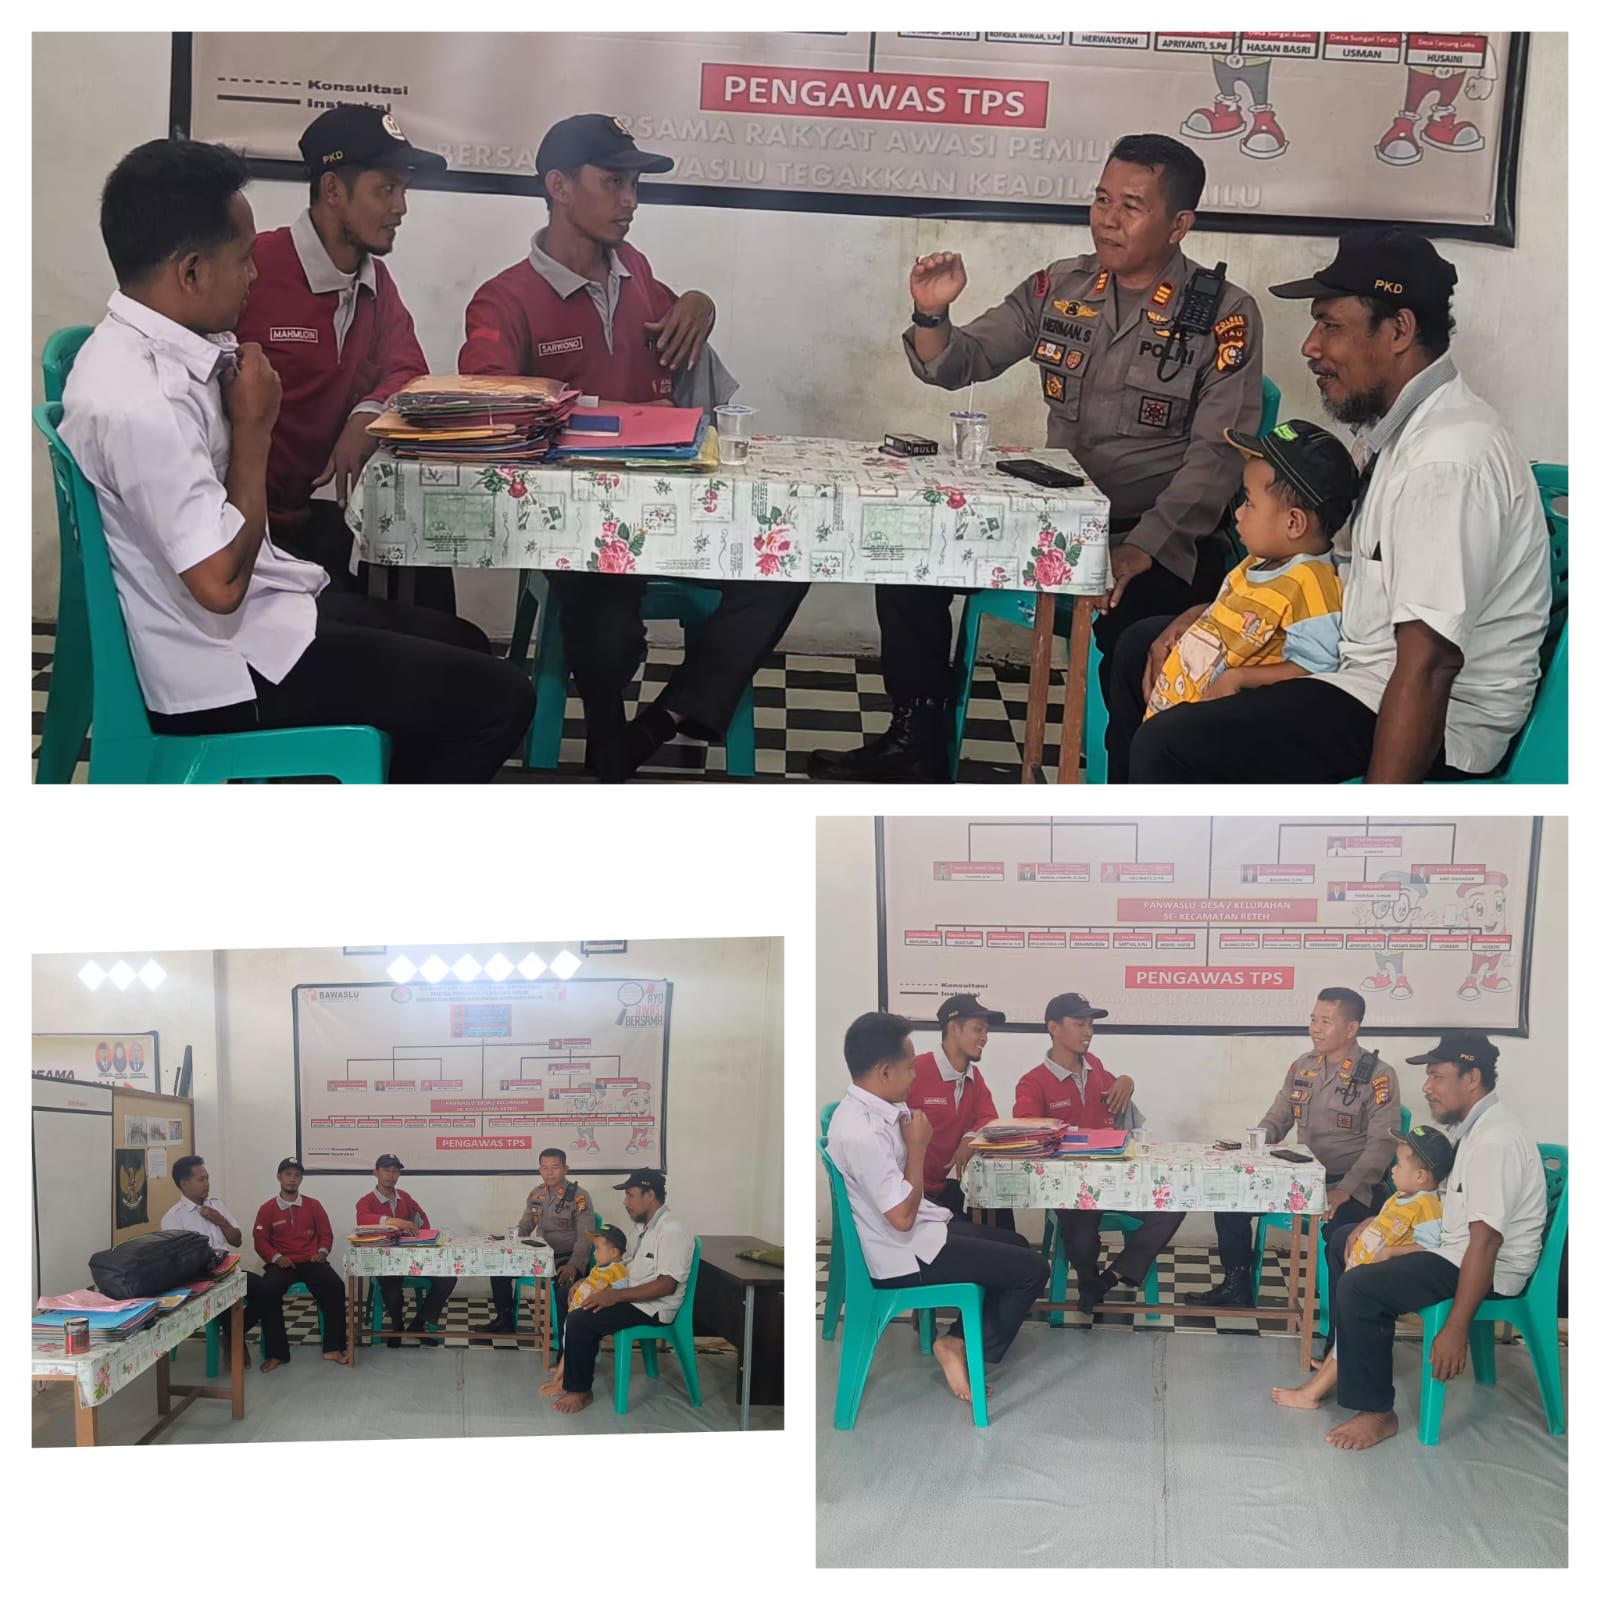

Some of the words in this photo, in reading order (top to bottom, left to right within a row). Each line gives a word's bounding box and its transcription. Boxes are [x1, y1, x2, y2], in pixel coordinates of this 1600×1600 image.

[1081, 34, 1138, 45] HERWANSYAH
[1162, 39, 1208, 50] APRIYANTI,
[1209, 41, 1227, 50] S.Pd
[1246, 43, 1280, 53] HASAN
[1282, 44, 1311, 54] BASRI
[1342, 48, 1382, 59] USMAN
[1426, 53, 1463, 64] HUSAINI
[307, 79, 409, 96] Konsultasi
[724, 75, 947, 113] PENGAWAS
[957, 88, 1025, 118] TPS
[745, 121, 877, 152] RAKYAT
[884, 127, 998, 158] AWASI
[322, 150, 344, 165] PKD
[778, 162, 957, 195] TEGAKKAN
[1373, 279, 1404, 295] PKD
[1143, 901, 1196, 910] PANWASLU
[1200, 901, 1225, 910] DESA
[1233, 901, 1291, 911] KELURAHAN
[1179, 913, 1238, 921] KECAMATAN
[1240, 913, 1270, 921] RETEH
[1136, 971, 1245, 985] PENGAWAS
[1249, 971, 1283, 986] TPS
[319, 991, 360, 999] BAWASLU
[647, 993, 664, 1004] AYO
[624, 1015, 664, 1027] BERSAMA
[442, 1139, 504, 1148] PENGAWAS
[506, 1138, 526, 1148] TPS
